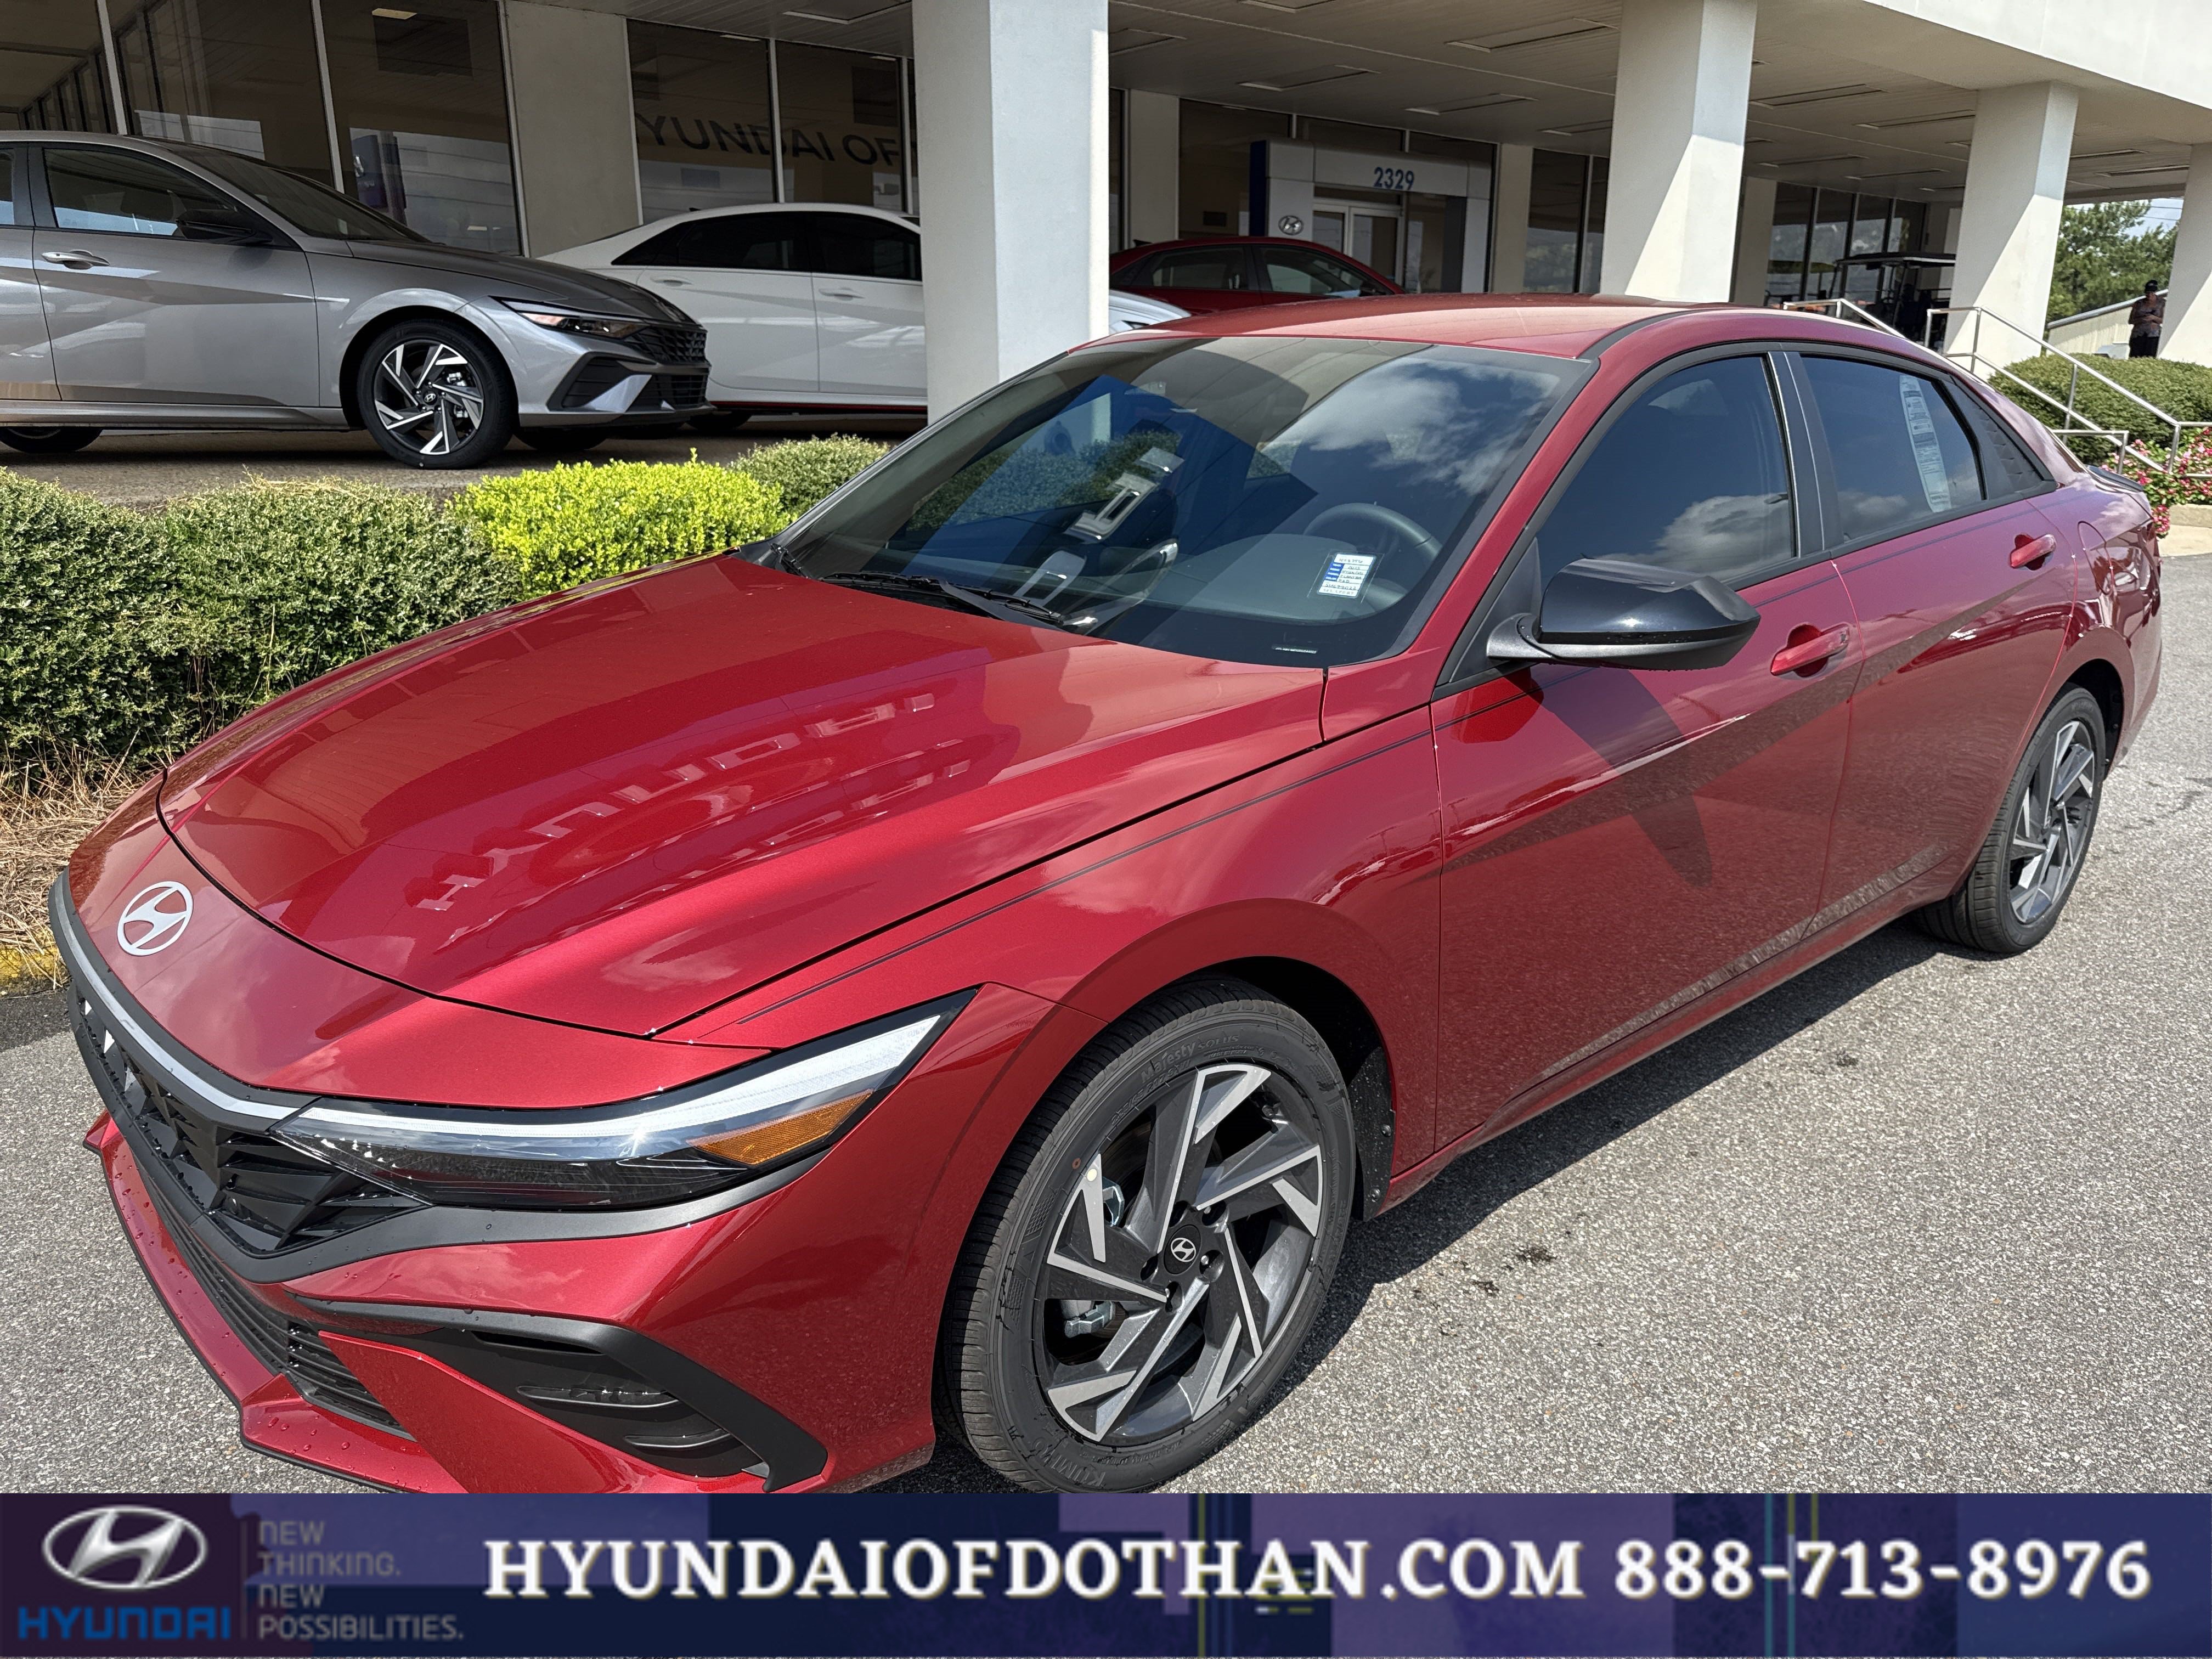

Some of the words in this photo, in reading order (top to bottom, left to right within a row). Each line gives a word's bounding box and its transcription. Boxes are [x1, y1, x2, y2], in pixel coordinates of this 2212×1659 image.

[635, 112, 836, 162] YUNDAI
[842, 134, 900, 166] OF
[1374, 166, 1415, 191] 2329
